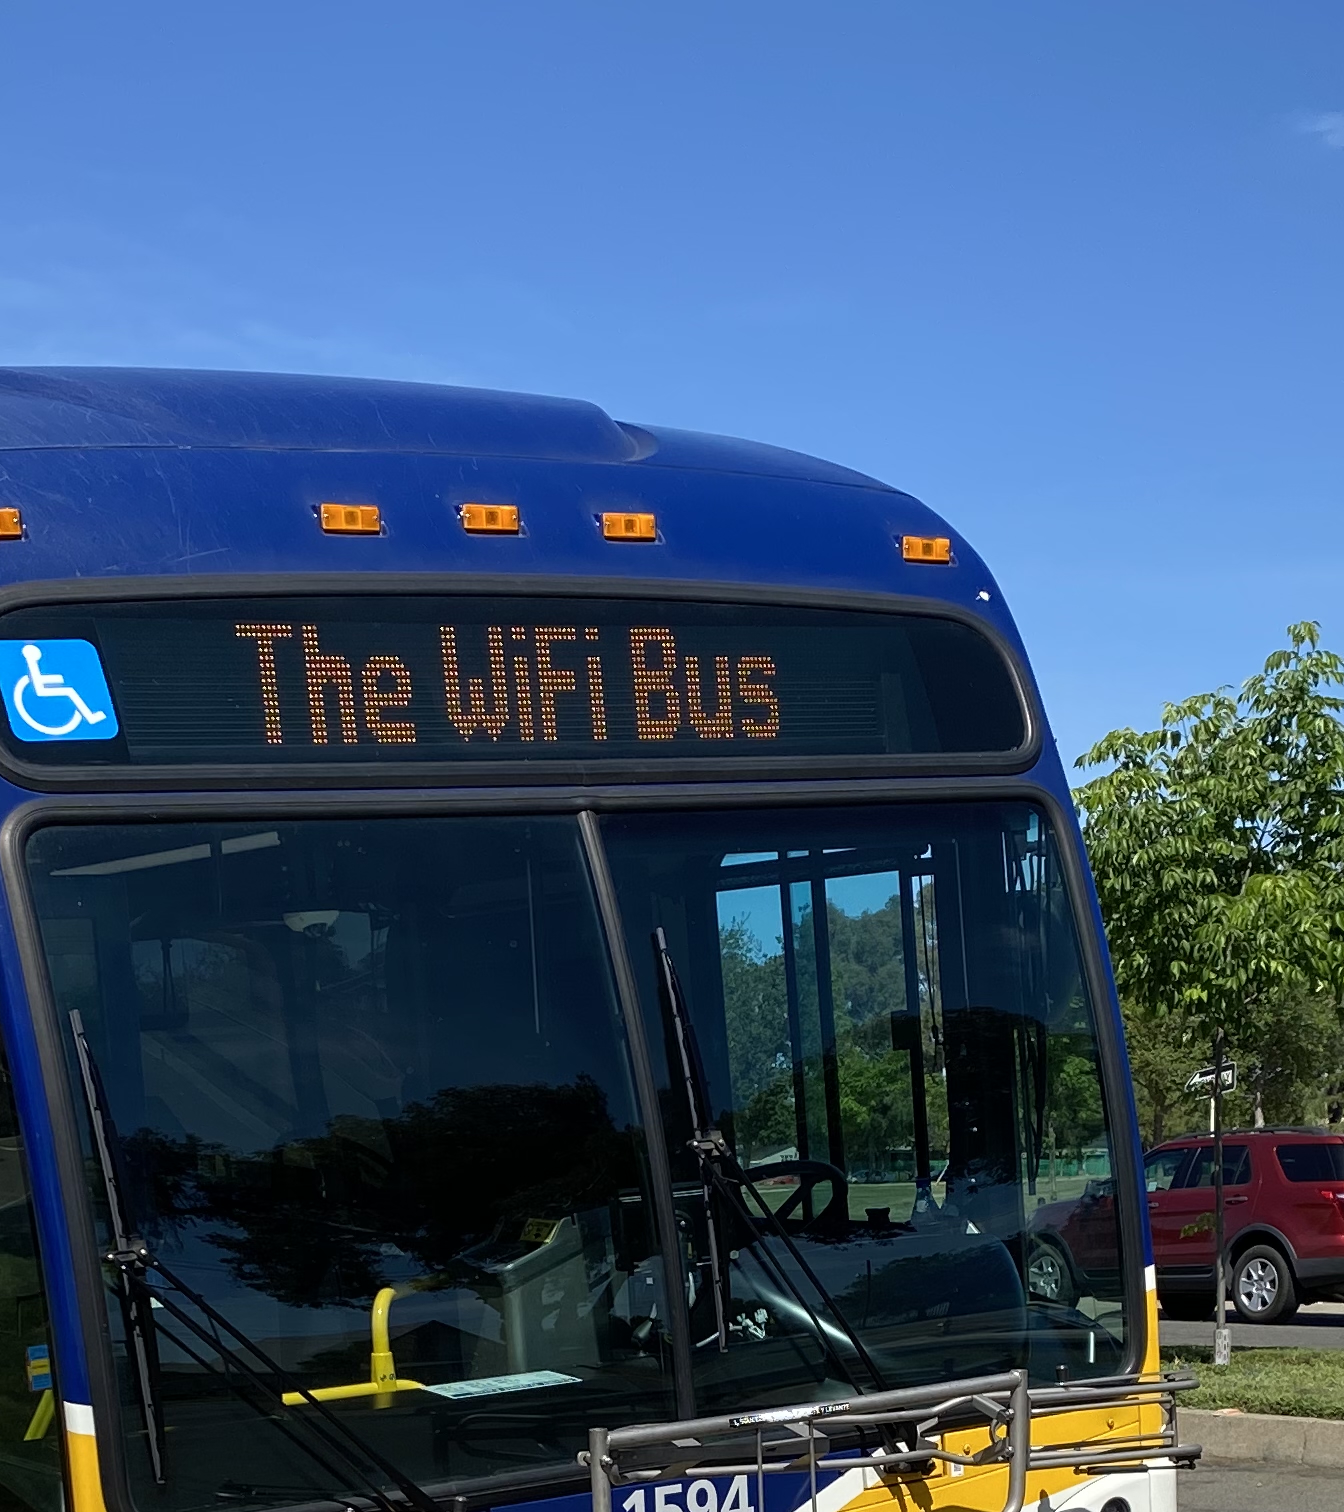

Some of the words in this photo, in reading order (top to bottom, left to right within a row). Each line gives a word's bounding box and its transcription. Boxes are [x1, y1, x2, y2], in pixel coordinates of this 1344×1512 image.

[235, 624, 416, 745] The
[439, 625, 608, 742] WiFi
[628, 626, 780, 741] Bus
